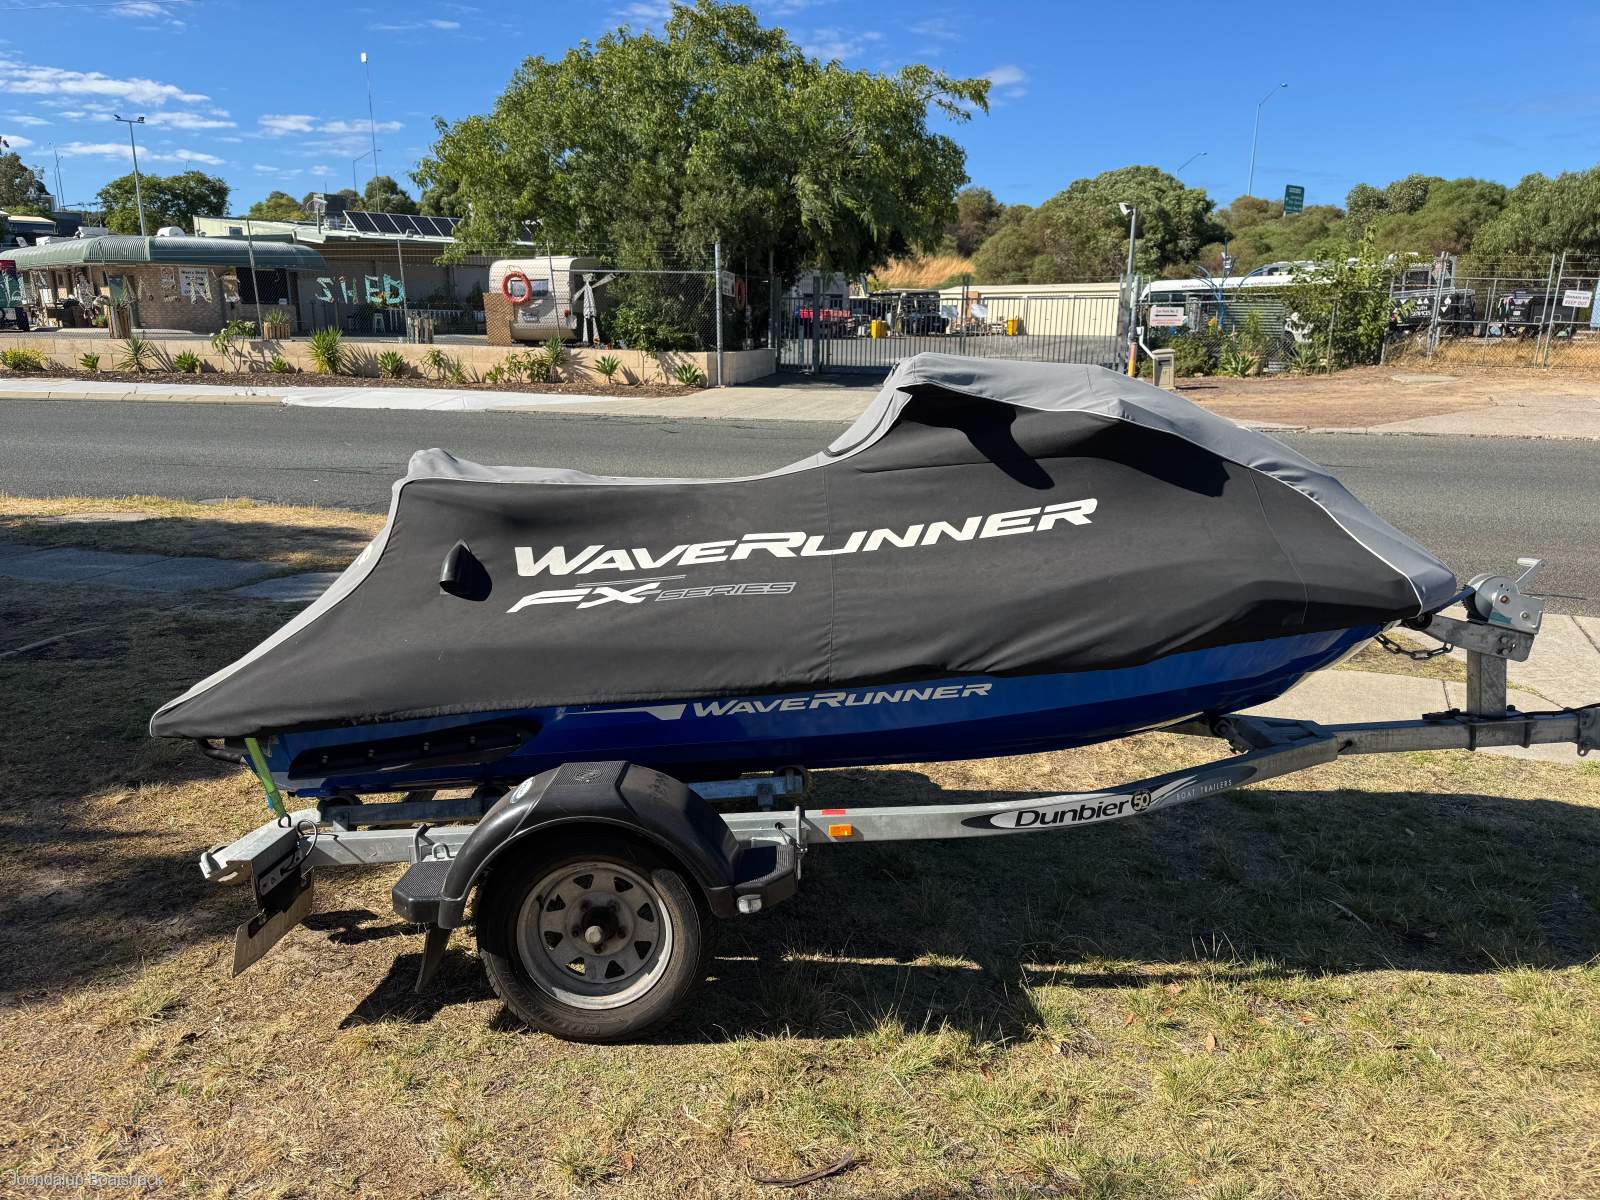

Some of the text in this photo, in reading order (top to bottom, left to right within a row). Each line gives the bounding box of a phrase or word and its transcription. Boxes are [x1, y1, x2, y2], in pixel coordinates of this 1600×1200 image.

[506, 581, 797, 613] FX SERIES
[1176, 779, 1232, 801] BOAT TRAILERS
[1014, 799, 1130, 828] Dunbier
